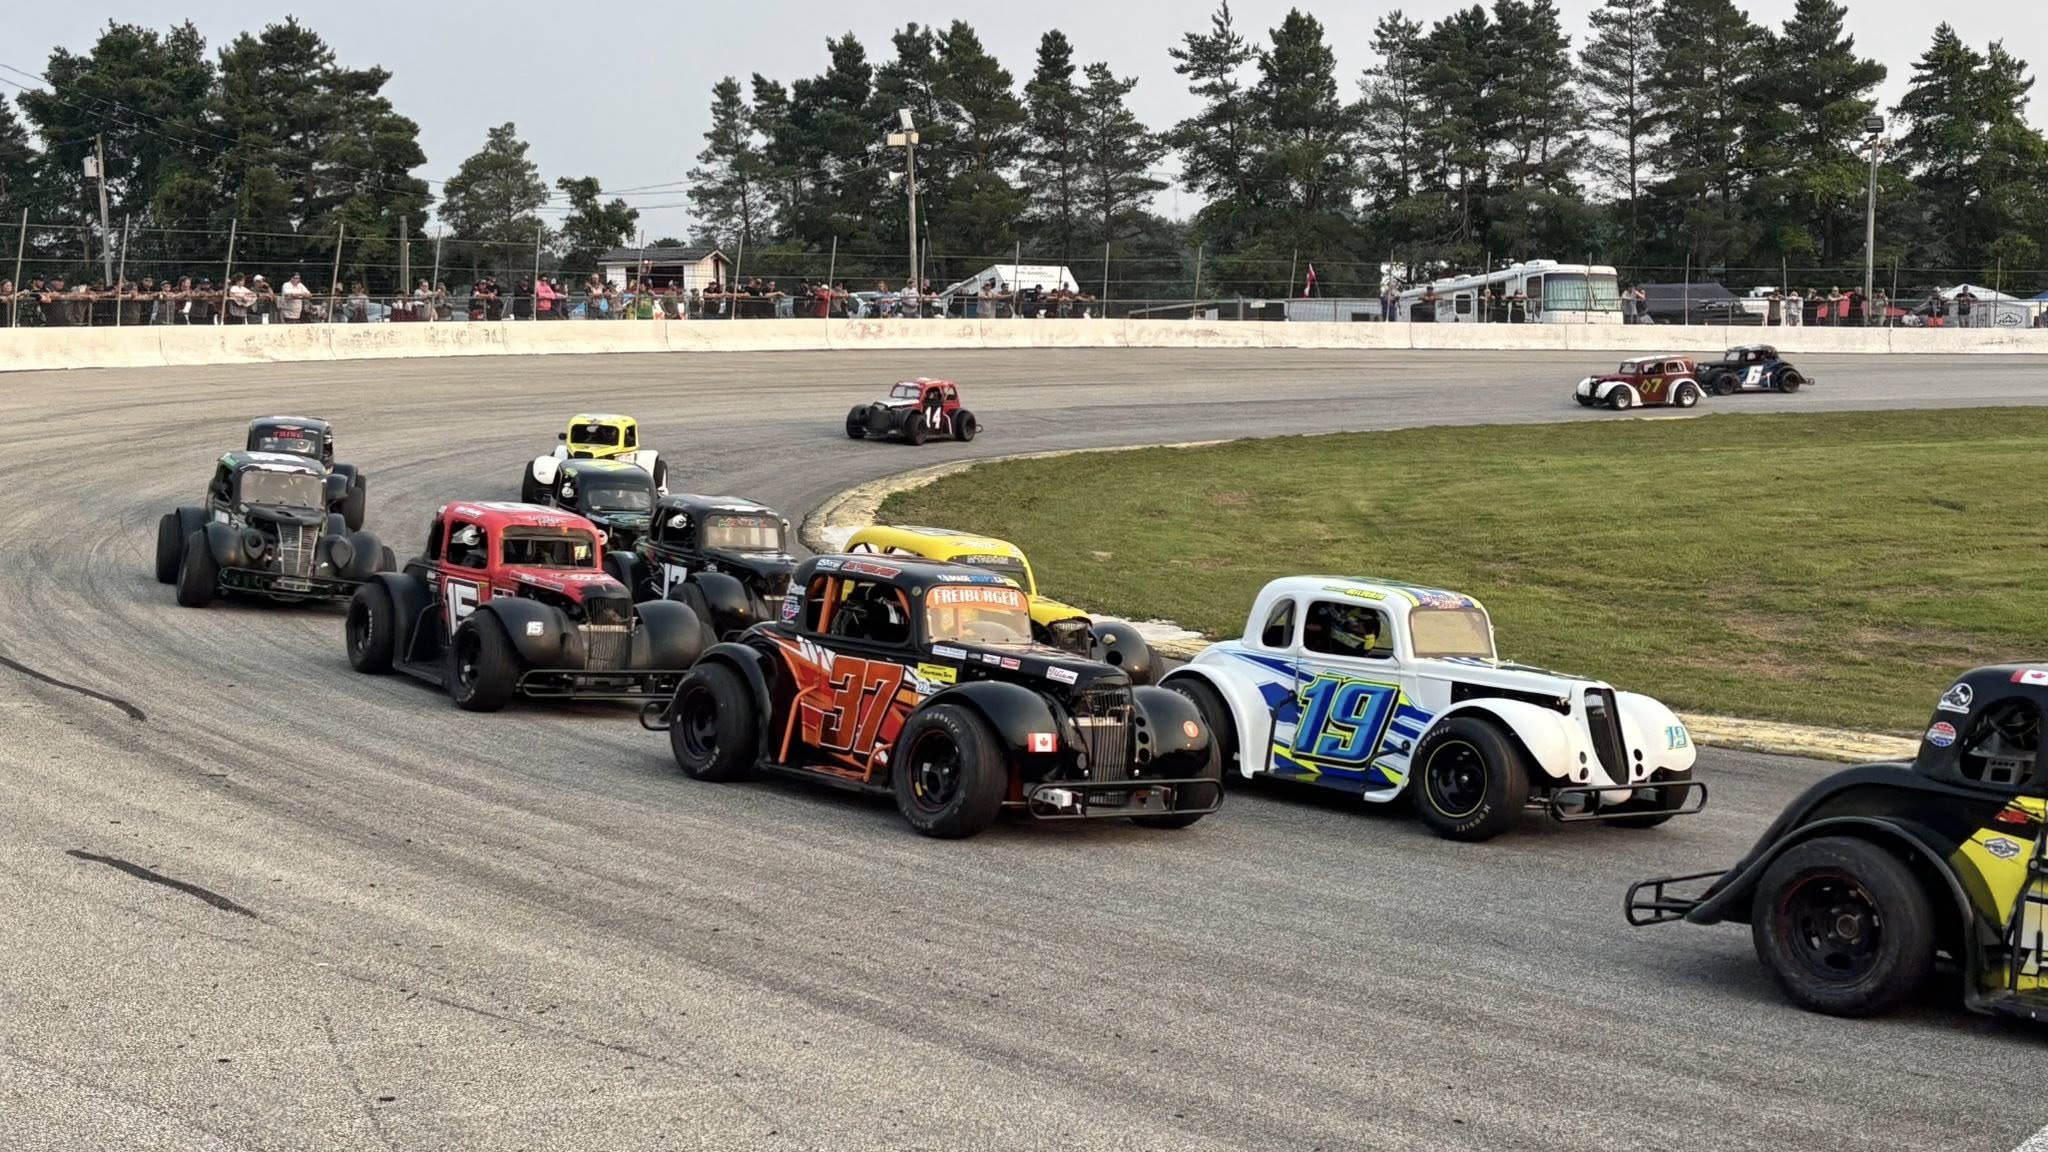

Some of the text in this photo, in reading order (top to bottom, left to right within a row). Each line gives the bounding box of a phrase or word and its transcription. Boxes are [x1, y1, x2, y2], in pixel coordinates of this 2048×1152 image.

[1639, 377, 1663, 394] 07
[925, 406, 942, 429] 14
[446, 582, 478, 636] 15
[933, 589, 1019, 607] FREIBURGER
[526, 620, 544, 636] 15
[819, 655, 904, 755] 37
[1291, 674, 1401, 771] 19
[1665, 726, 1688, 750] 19
